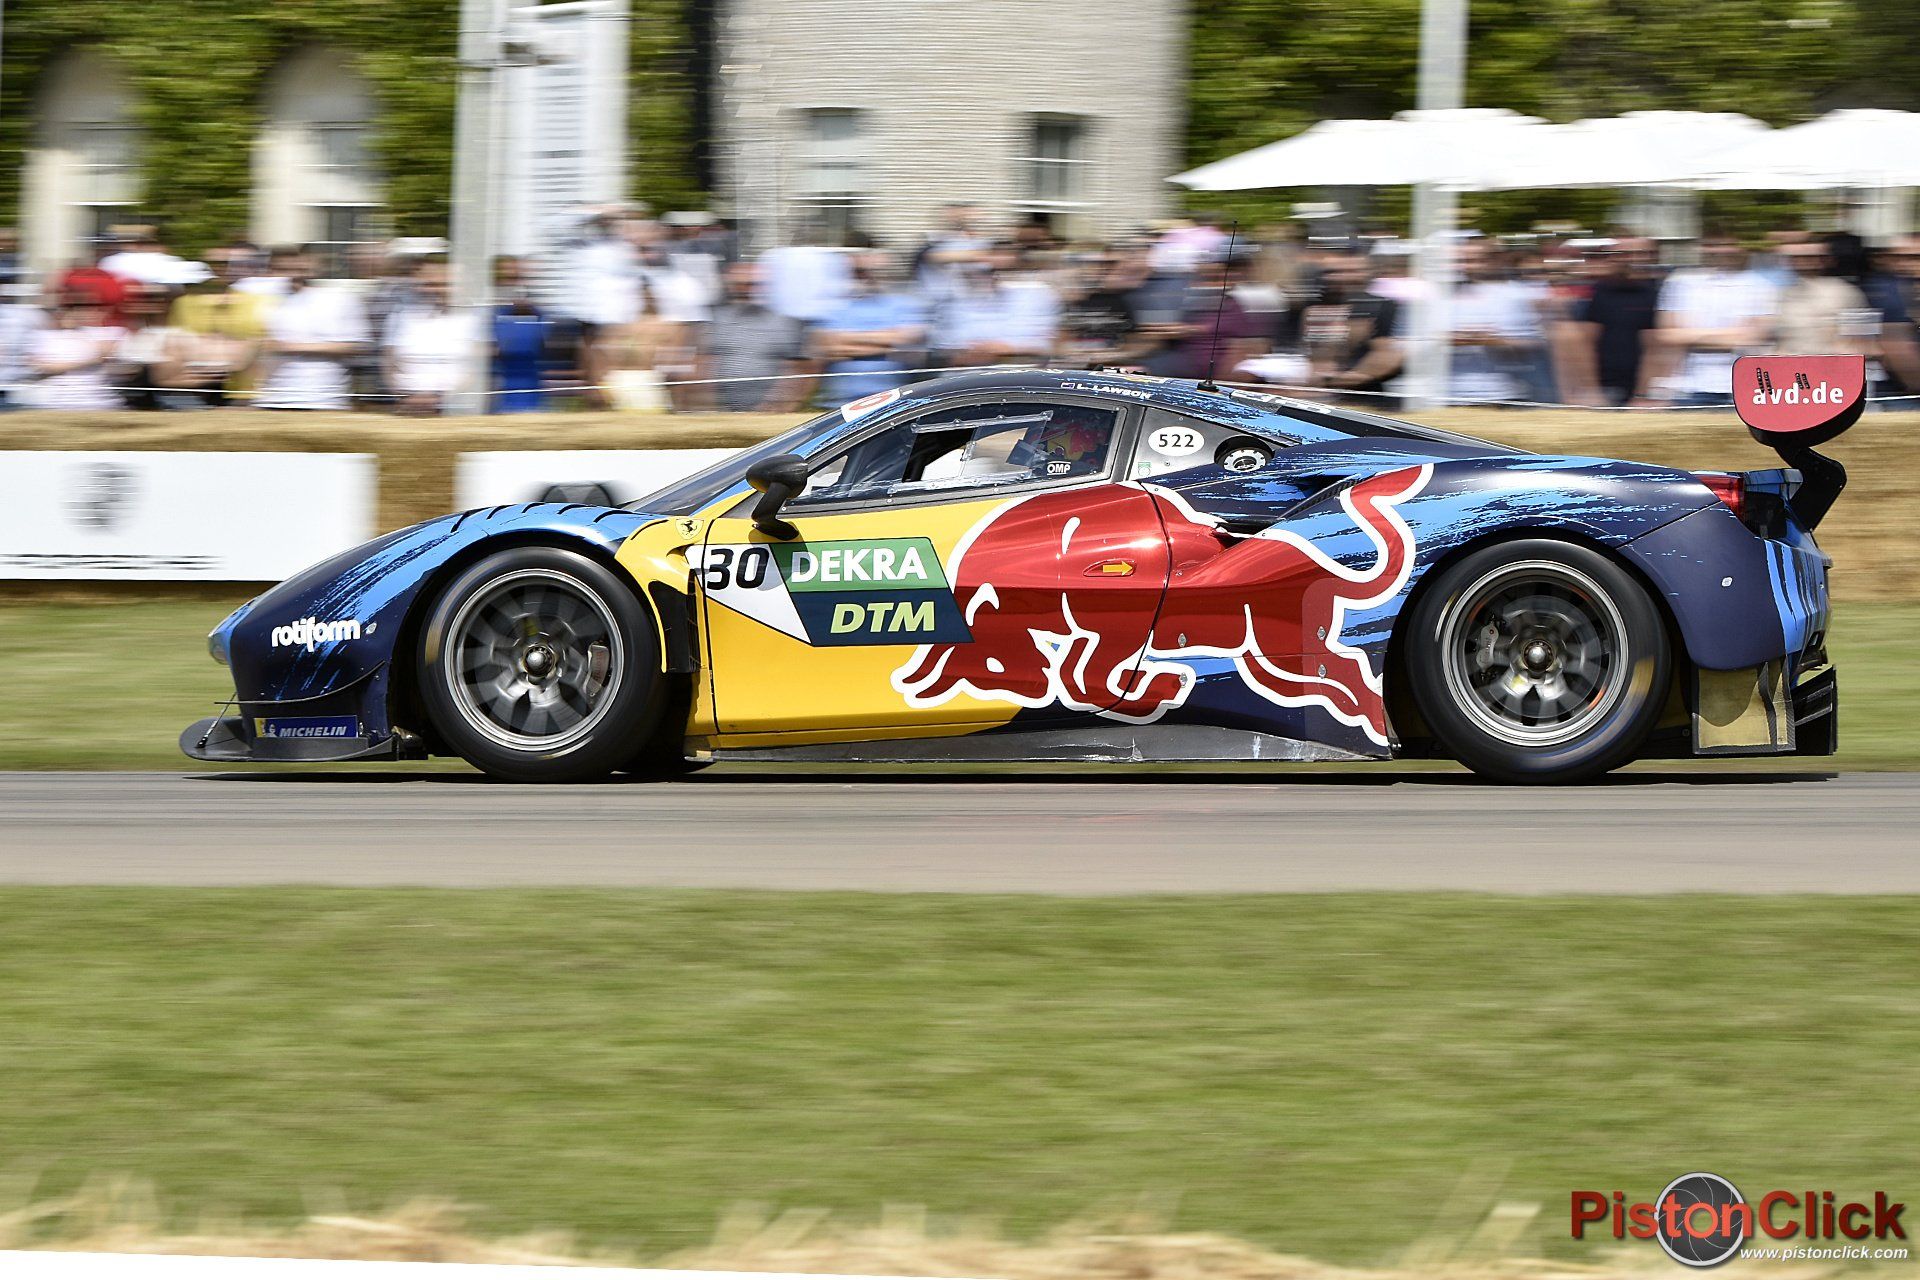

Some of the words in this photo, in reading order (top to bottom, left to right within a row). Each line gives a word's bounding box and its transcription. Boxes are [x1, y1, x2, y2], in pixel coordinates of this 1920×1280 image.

[1093, 385, 1152, 400] LAWSON
[1752, 381, 1844, 405] avd.de
[1159, 434, 1194, 448] 522
[1047, 463, 1071, 474] OMP
[706, 547, 770, 590] 30
[791, 547, 928, 583] DEKRA
[830, 601, 935, 633] DTM
[271, 617, 361, 652] rotiform
[279, 725, 347, 737] MICHELIN
